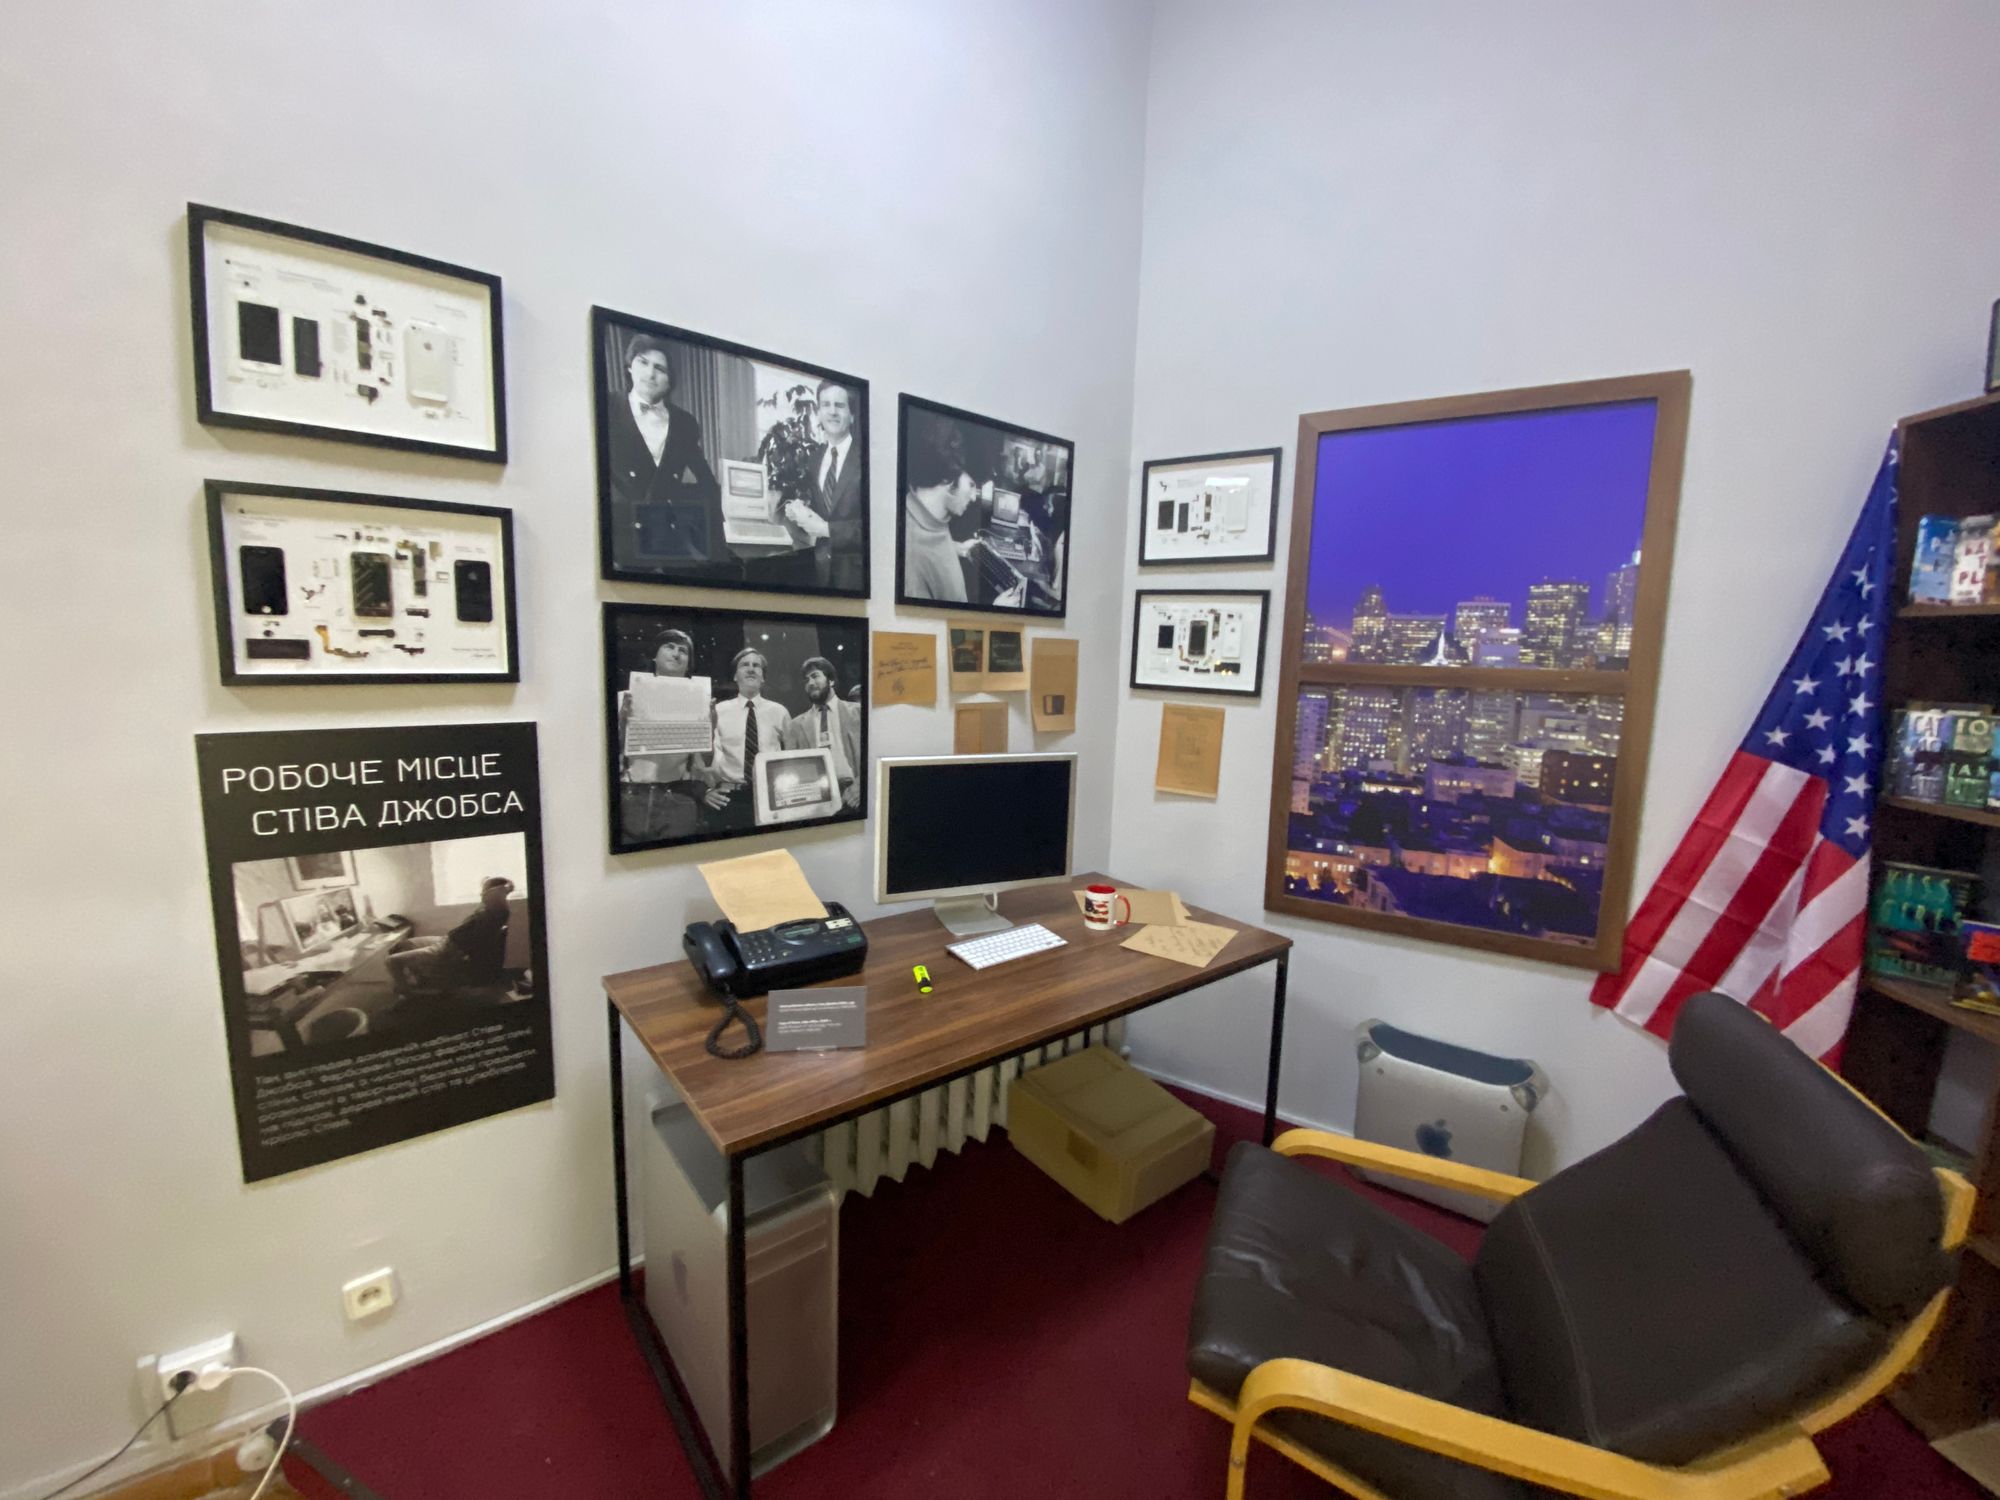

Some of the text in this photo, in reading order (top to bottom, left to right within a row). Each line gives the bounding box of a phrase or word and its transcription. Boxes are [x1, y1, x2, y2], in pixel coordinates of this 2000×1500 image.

[222, 752, 501, 794] РОБОЧЕ МІСЦЕ
[251, 790, 524, 836] СТІВА ДЖОБСА
